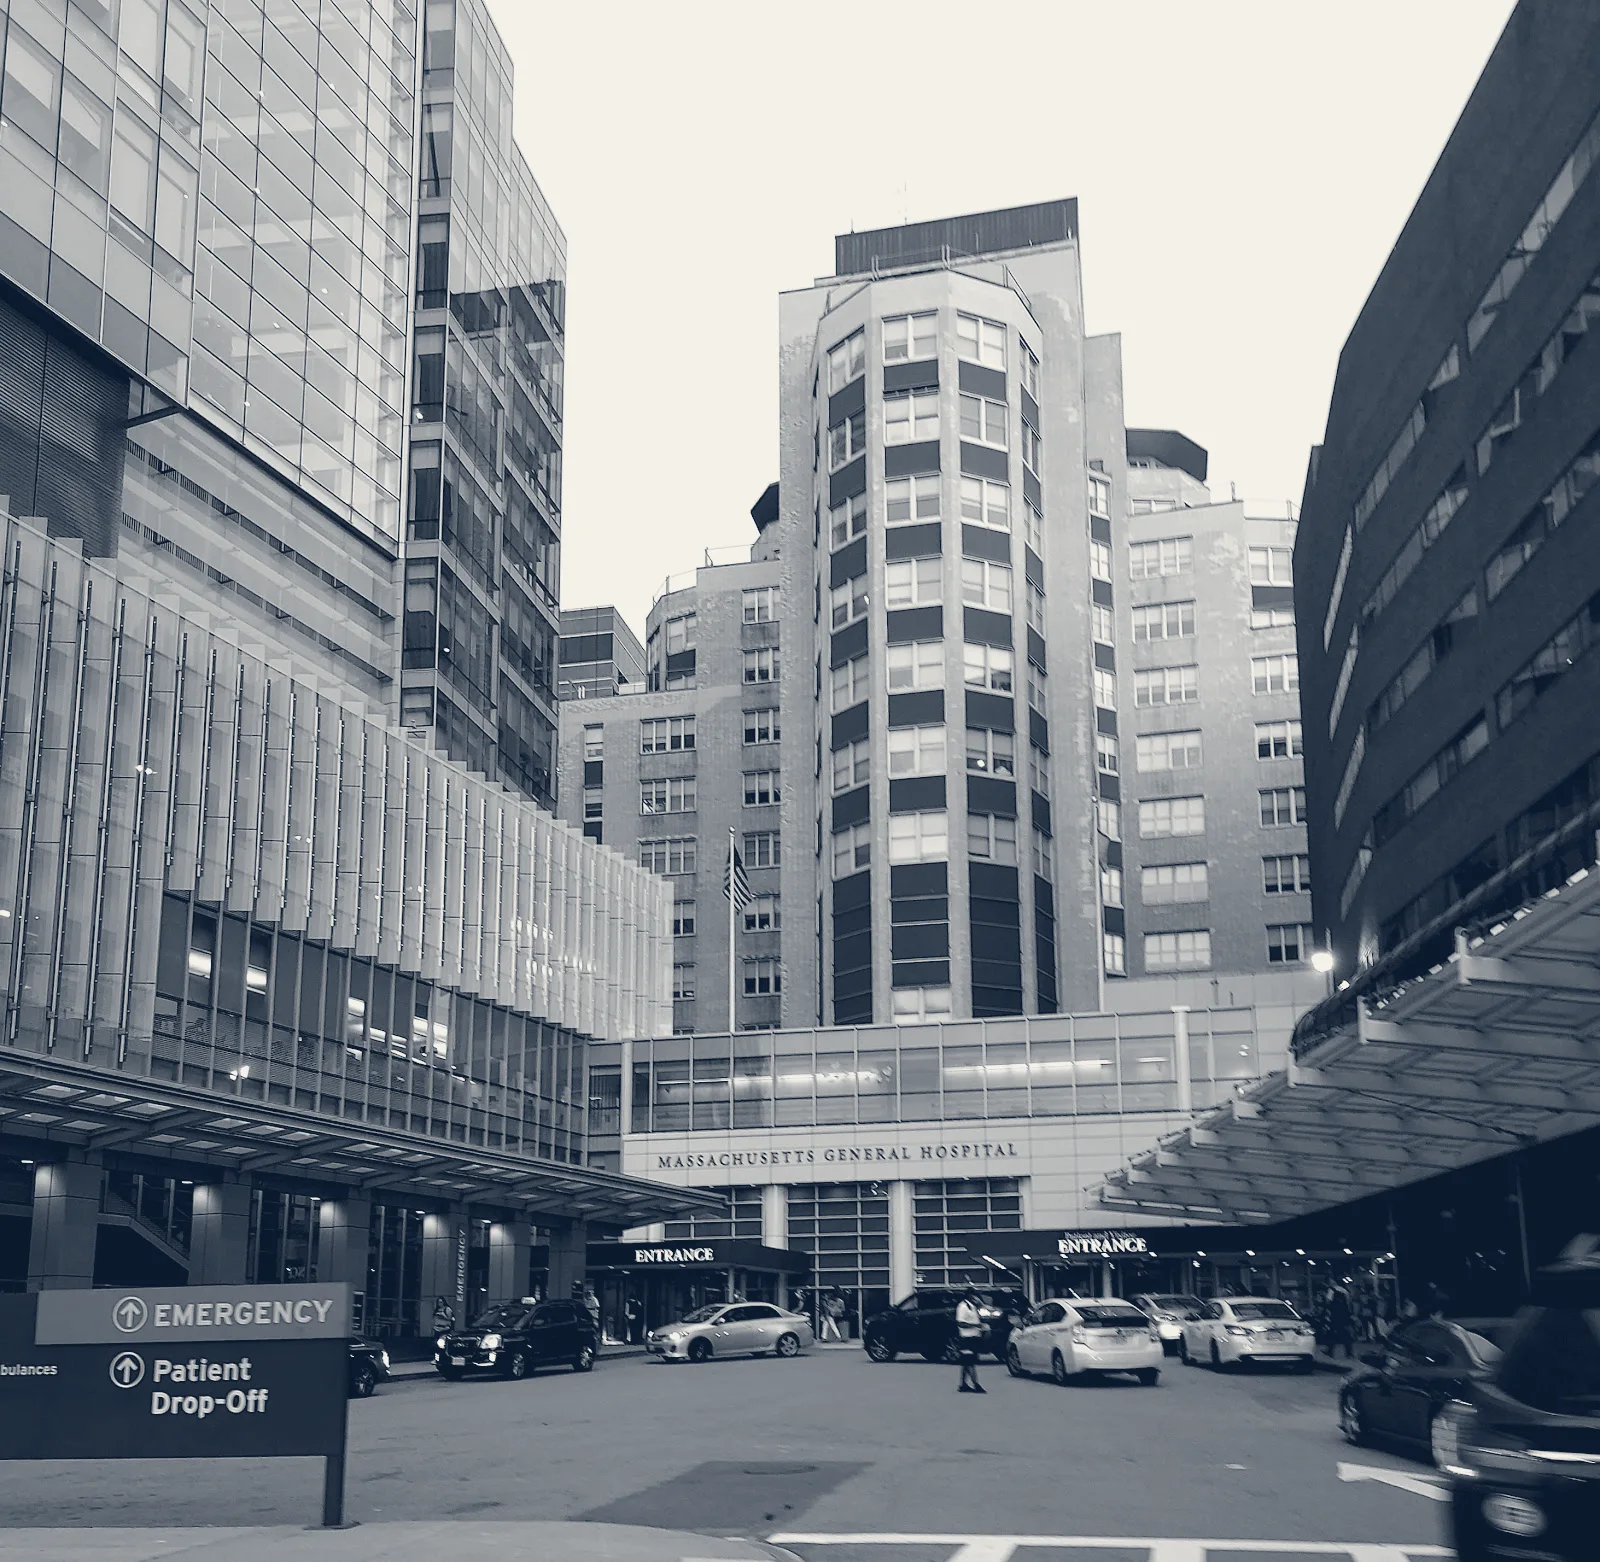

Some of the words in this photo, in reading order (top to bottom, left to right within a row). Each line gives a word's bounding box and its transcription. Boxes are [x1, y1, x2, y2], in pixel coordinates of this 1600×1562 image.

[658, 1149, 815, 1169] MASSACHUSETTS
[824, 1146, 911, 1162] GENERAL
[920, 1142, 1017, 1160] HOSPITAL
[635, 1248, 714, 1262] ENTRANCE
[1058, 1238, 1147, 1254] ENTRANCE
[456, 1229, 466, 1302] EMERGENCY
[154, 1300, 333, 1327] EMERGENCY
[0, 1364, 58, 1376] bulances
[153, 1357, 252, 1382] Patient
[151, 1389, 268, 1418] Drop-Off
